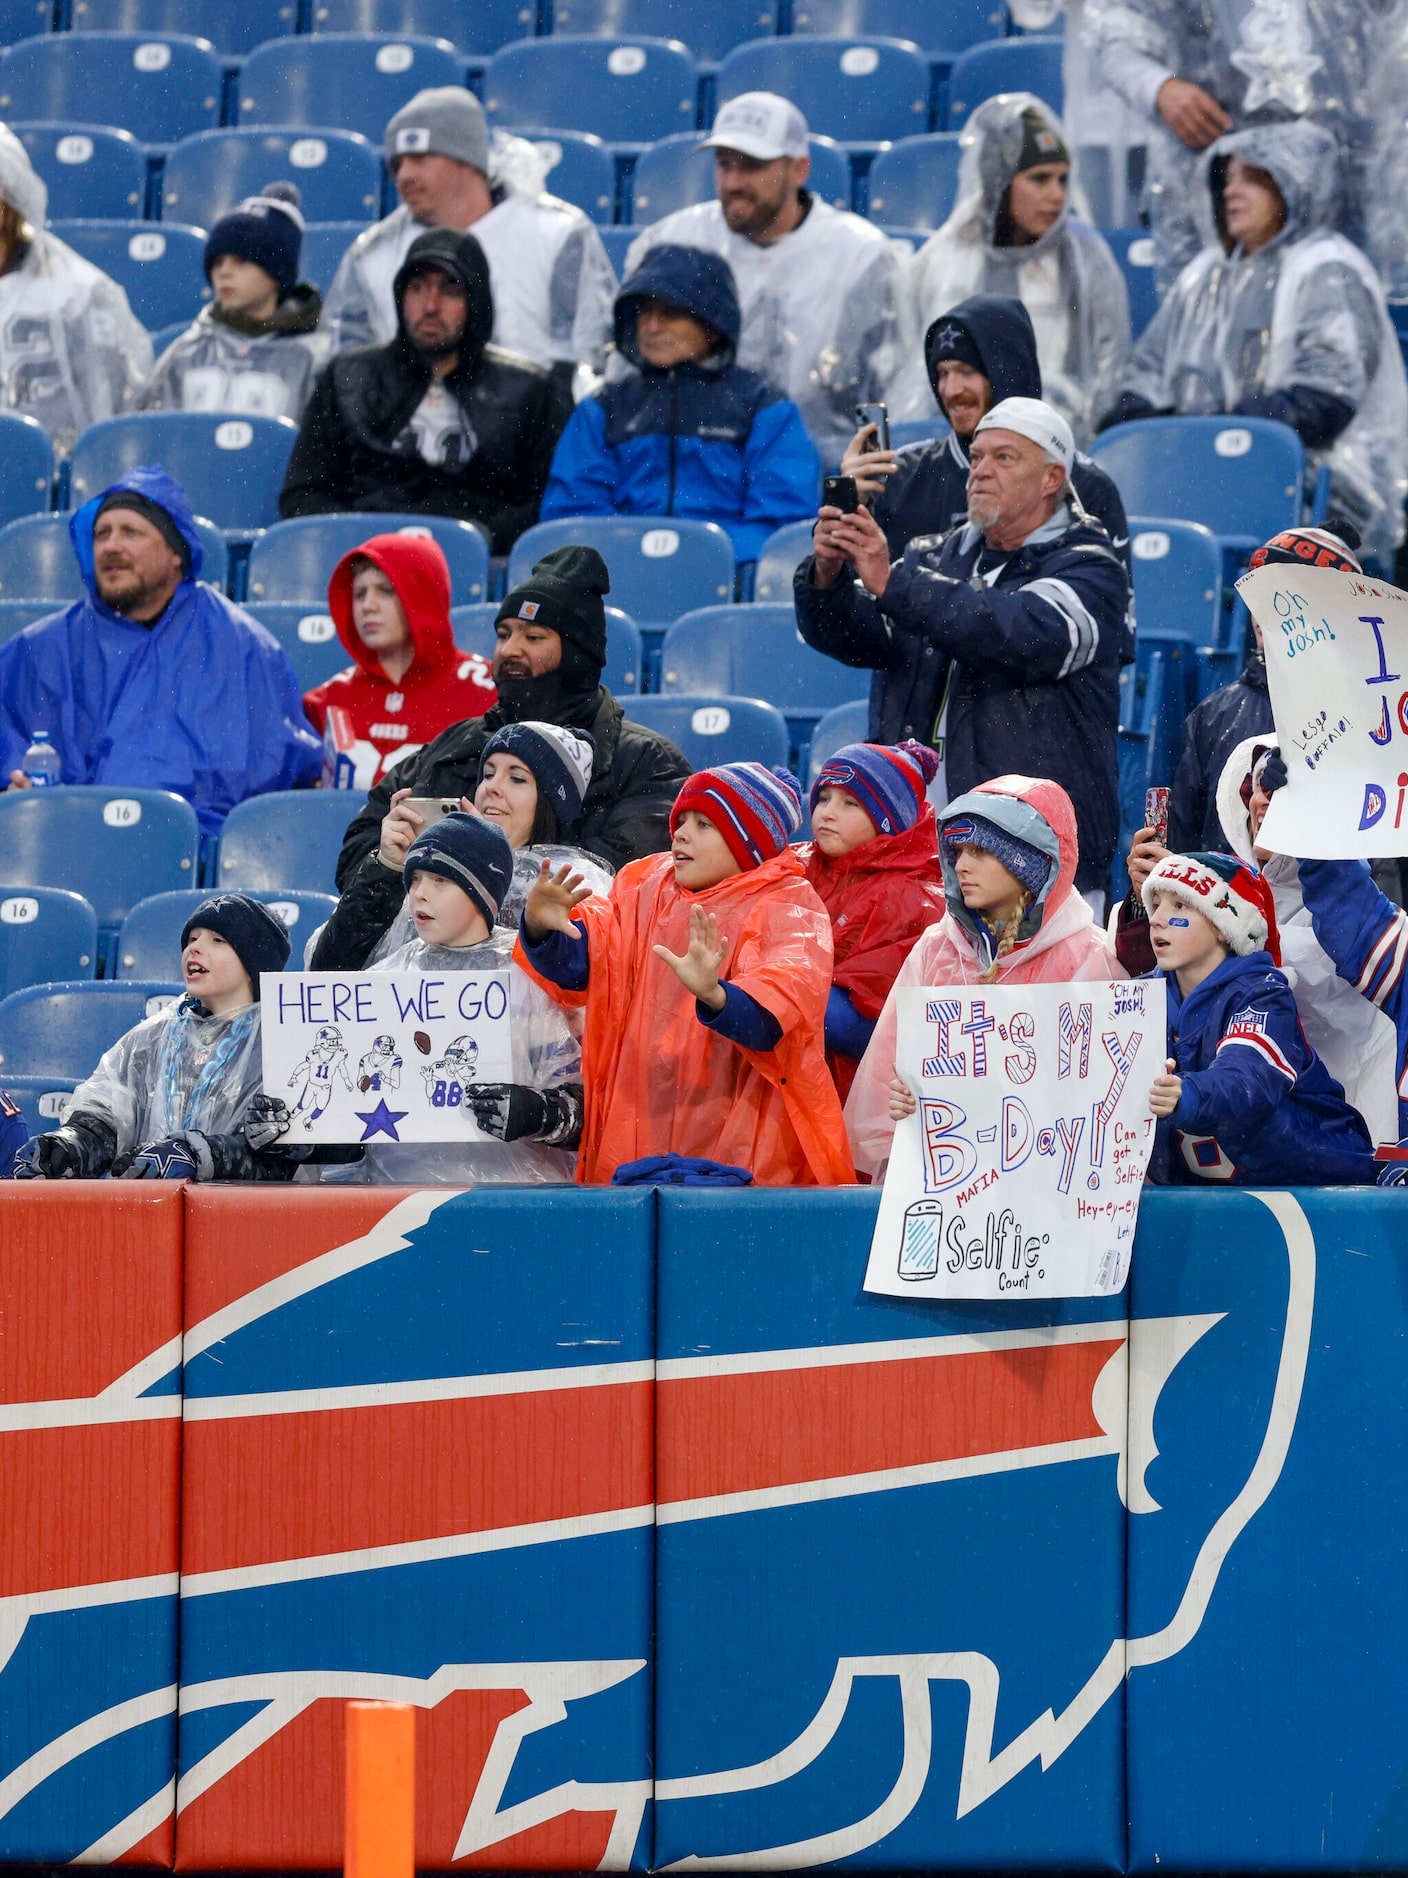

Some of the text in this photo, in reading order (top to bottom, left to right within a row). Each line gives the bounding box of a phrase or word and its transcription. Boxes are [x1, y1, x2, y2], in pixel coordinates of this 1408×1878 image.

[653, 536, 668, 552] 17
[310, 621, 326, 637] 16
[1358, 616, 1401, 685] I
[703, 713, 720, 730] 17
[115, 805, 131, 821] 16
[12, 903, 28, 918] 16
[279, 979, 508, 1025] HERE WE GO
[1230, 1021, 1260, 1035] NFL
[315, 1064, 330, 1080] 11
[370, 1072, 382, 1092] 4
[431, 1080, 463, 1107] 88
[1113, 1121, 1138, 1145] Can
[1112, 1144, 1132, 1165] get
[1114, 1164, 1145, 1185] Selfie
[955, 1168, 1001, 1210] MAFIA
